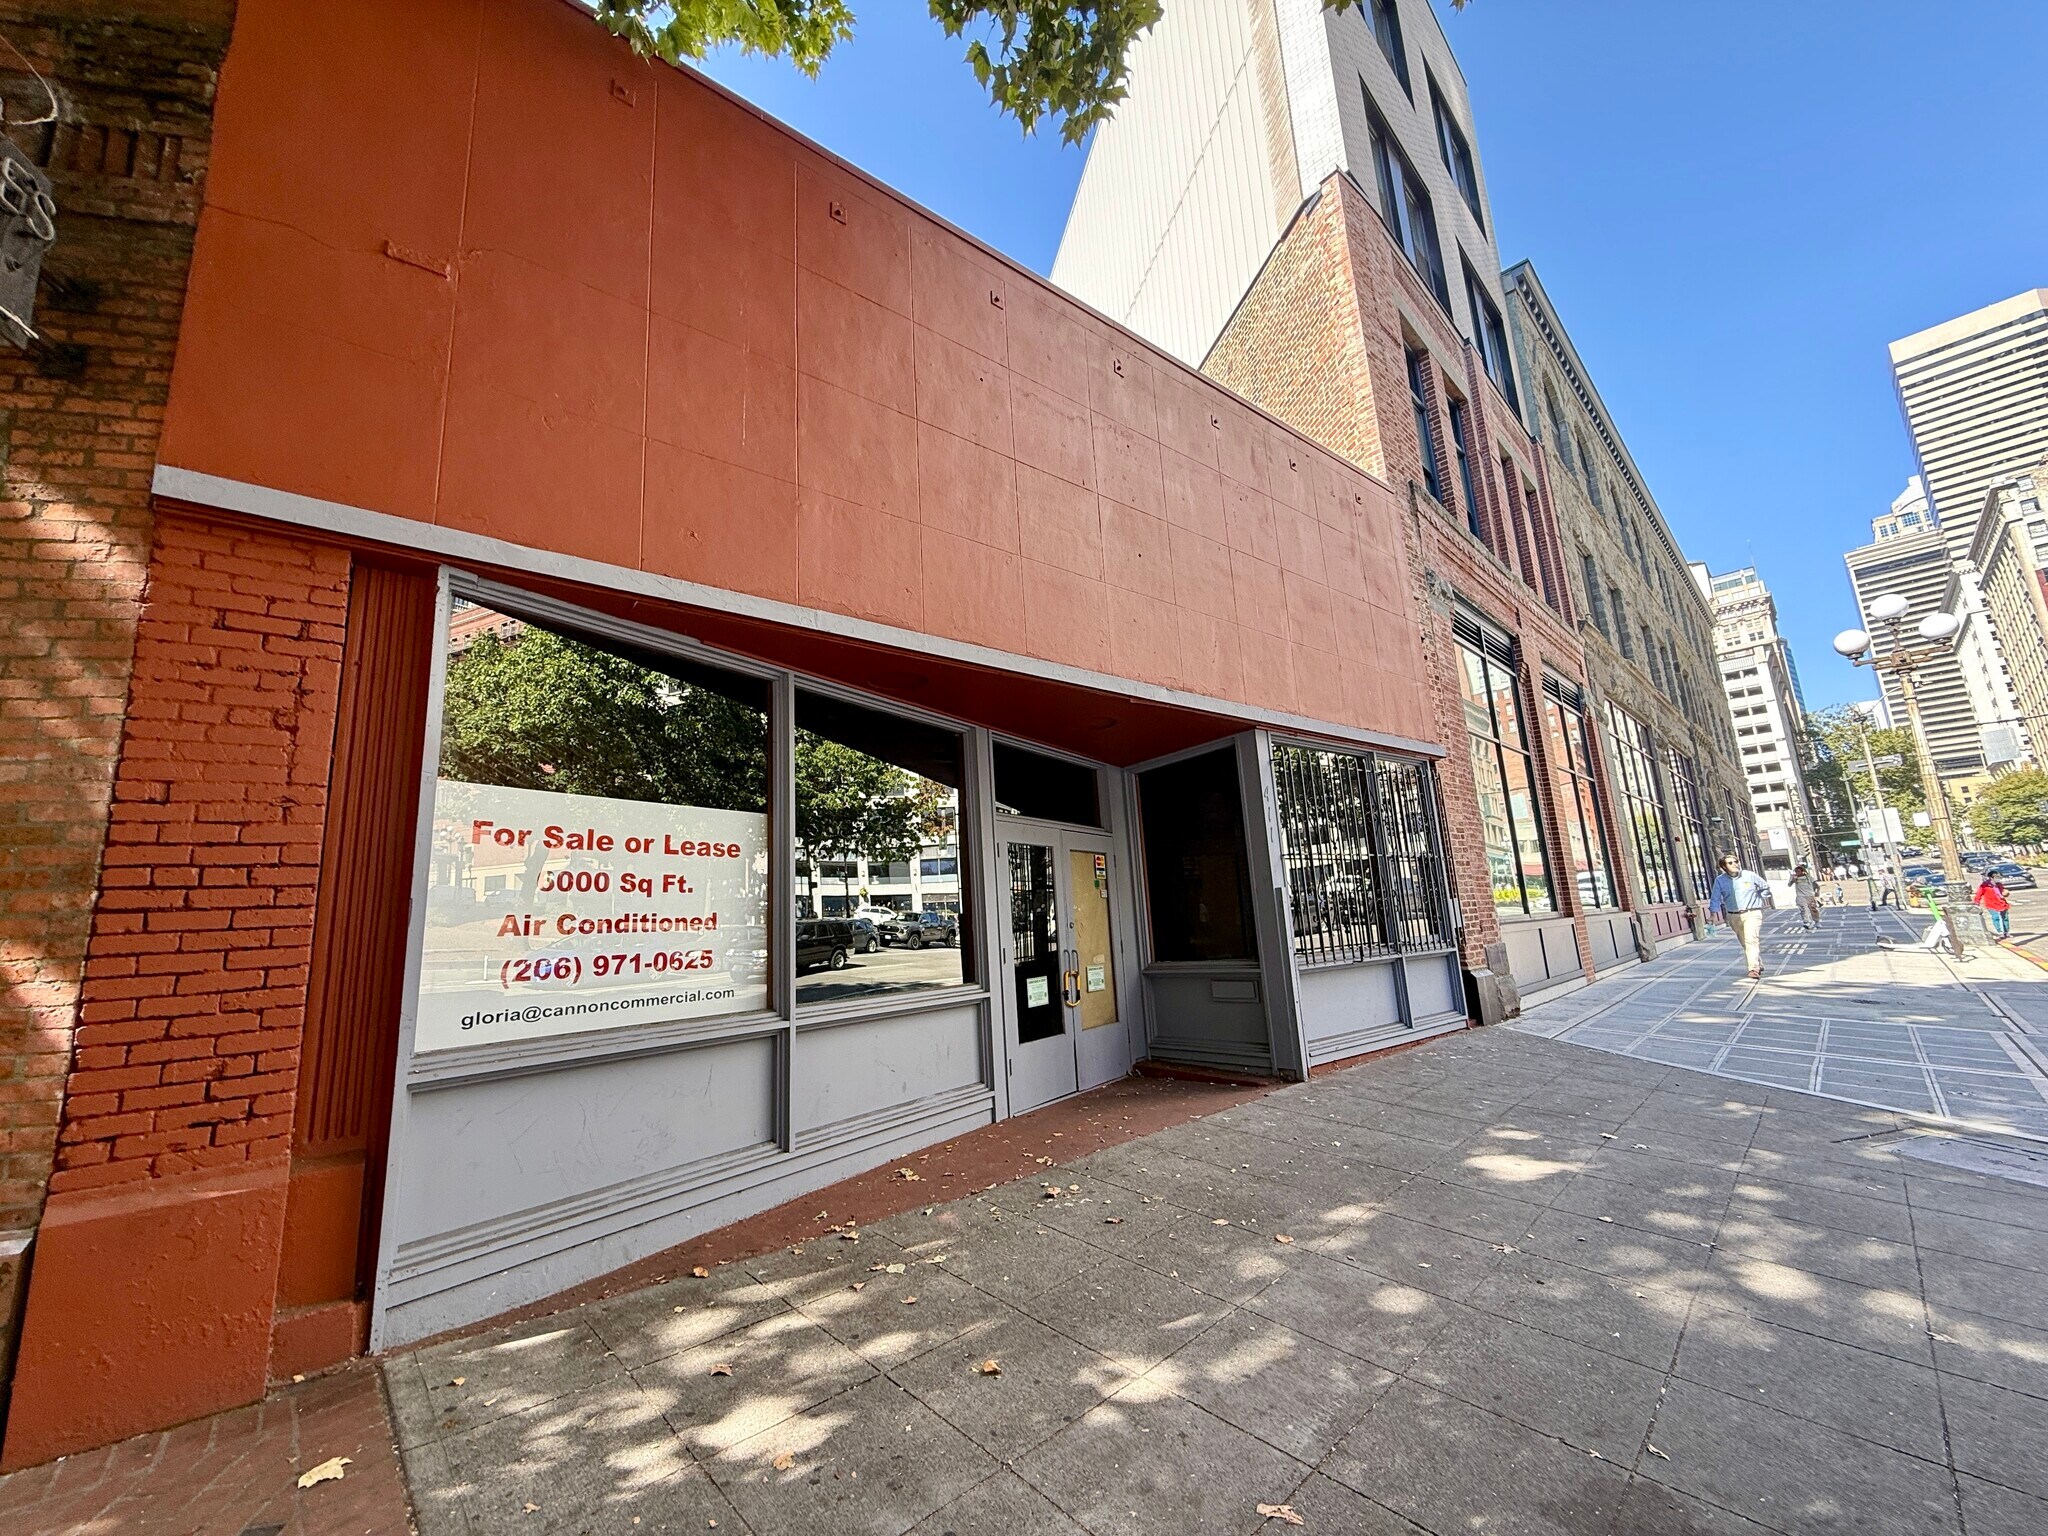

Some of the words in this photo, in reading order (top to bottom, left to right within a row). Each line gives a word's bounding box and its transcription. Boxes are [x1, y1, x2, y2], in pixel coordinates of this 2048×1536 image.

[471, 820, 532, 847] For
[543, 825, 614, 852] Sale
[624, 837, 655, 854] or
[664, 834, 741, 858] Lease
[537, 870, 609, 893] 6000
[619, 872, 652, 898] Sq
[662, 874, 693, 893] Ft.
[496, 914, 546, 937] Air
[556, 912, 718, 936] Conditioned
[500, 956, 582, 990] (206)
[593, 949, 713, 976] 971-0625
[461, 988, 735, 1030] gloria@cannoncommercial.com
